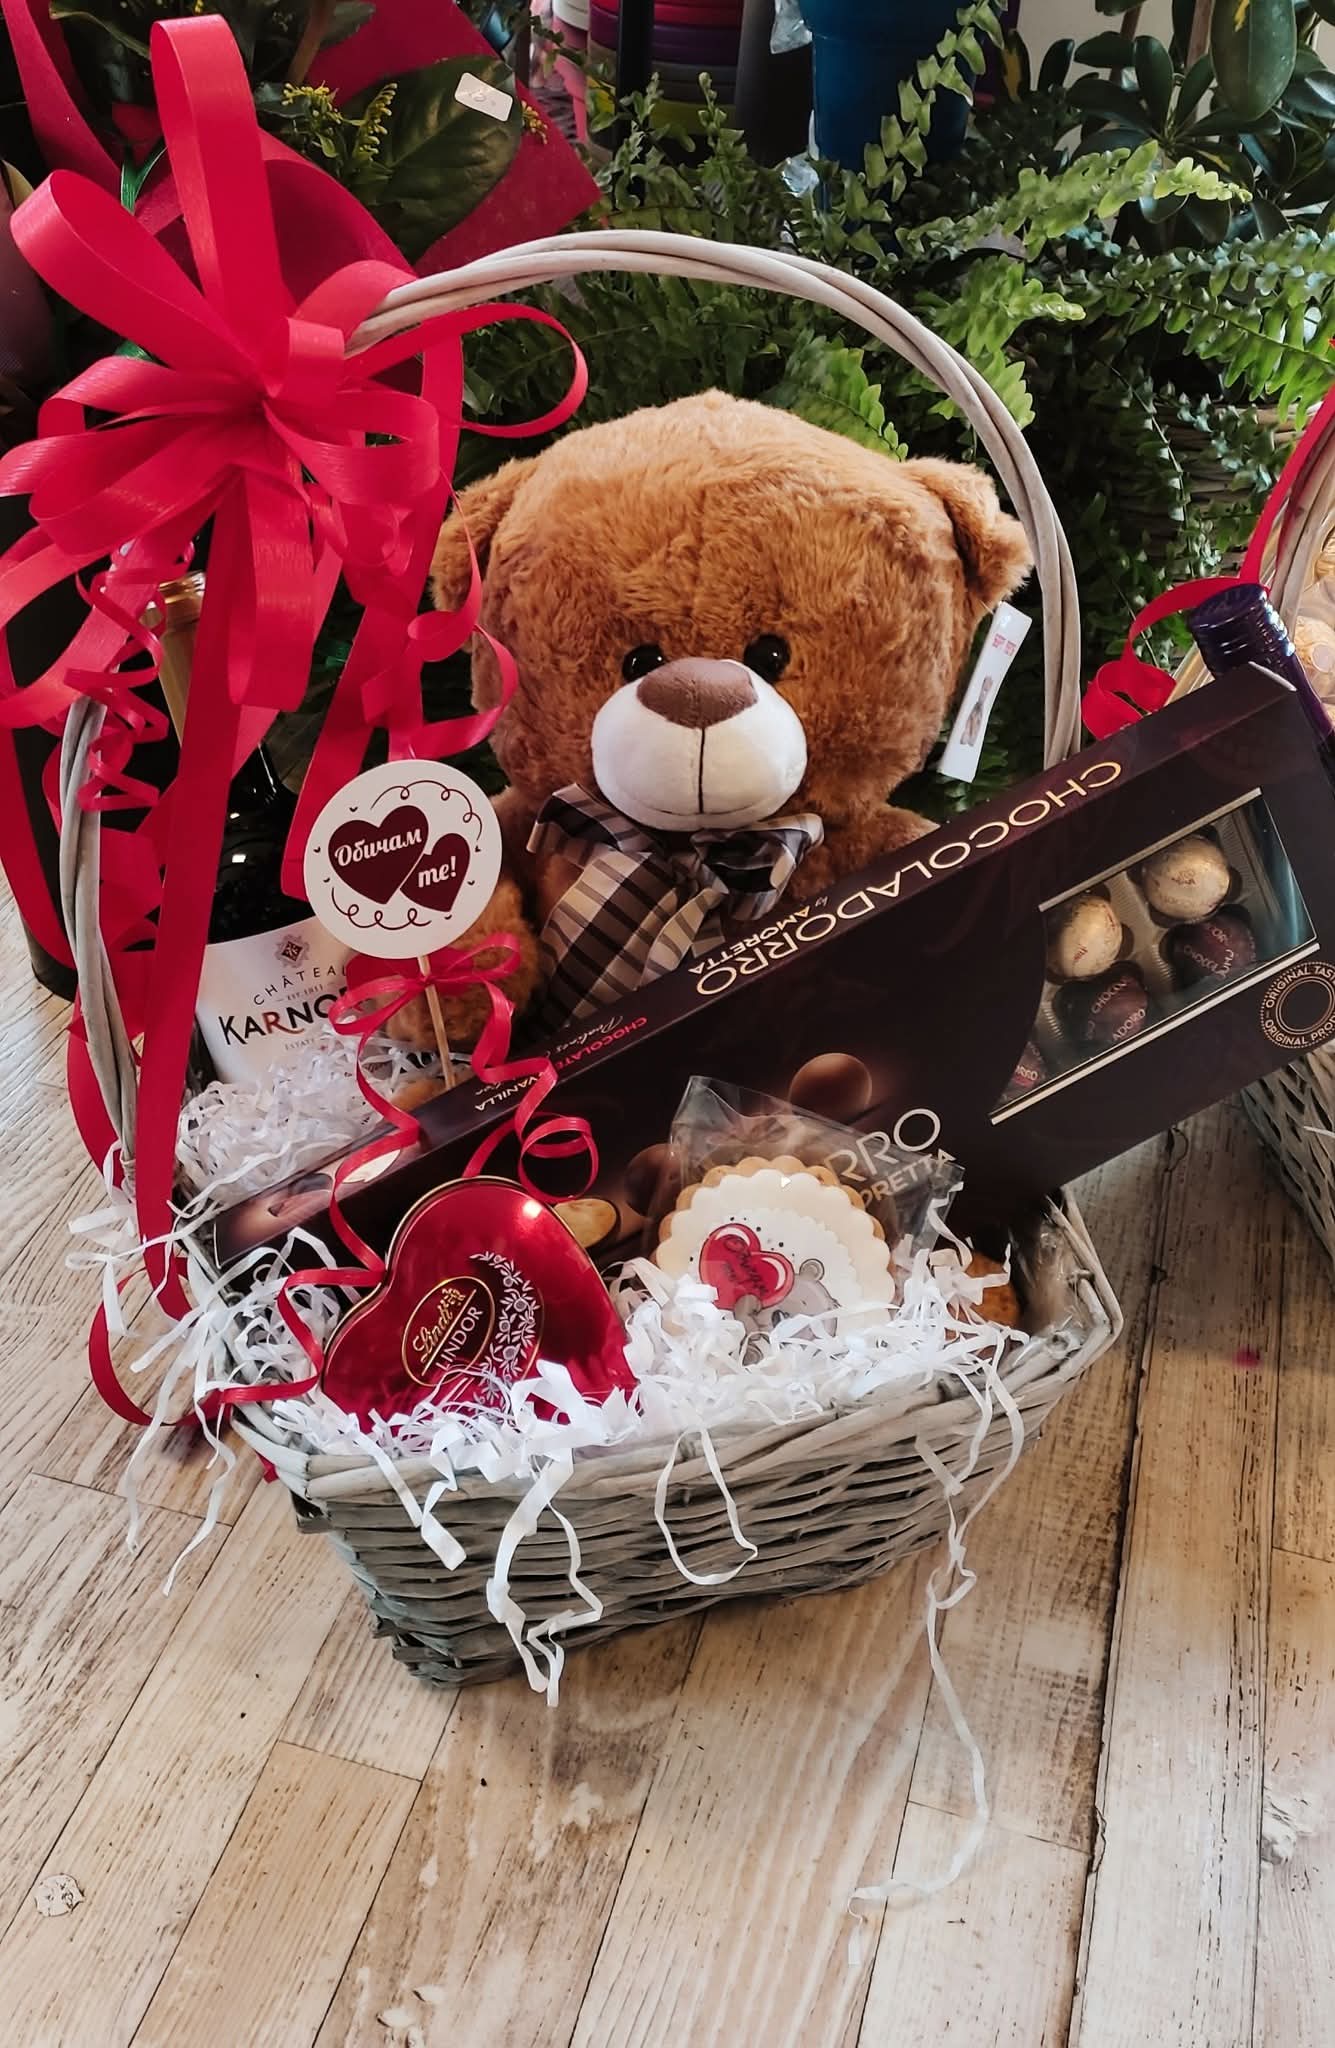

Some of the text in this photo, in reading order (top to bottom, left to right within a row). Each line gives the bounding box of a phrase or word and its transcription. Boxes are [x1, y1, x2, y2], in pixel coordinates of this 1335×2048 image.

[334, 828, 422, 867] Обичам
[417, 855, 457, 888] те!
[696, 761, 1122, 995] CHOCOLADORRO
[688, 905, 810, 974] AMORETTA
[218, 986, 347, 1045] KARNO
[1266, 965, 1311, 1008] ORIGINAL
[1264, 1012, 1335, 1046] ORIGINAL PROD
[824, 1108, 941, 1182] RRO
[412, 1303, 454, 1363] Lindt
[435, 1306, 484, 1371] LINDOR
